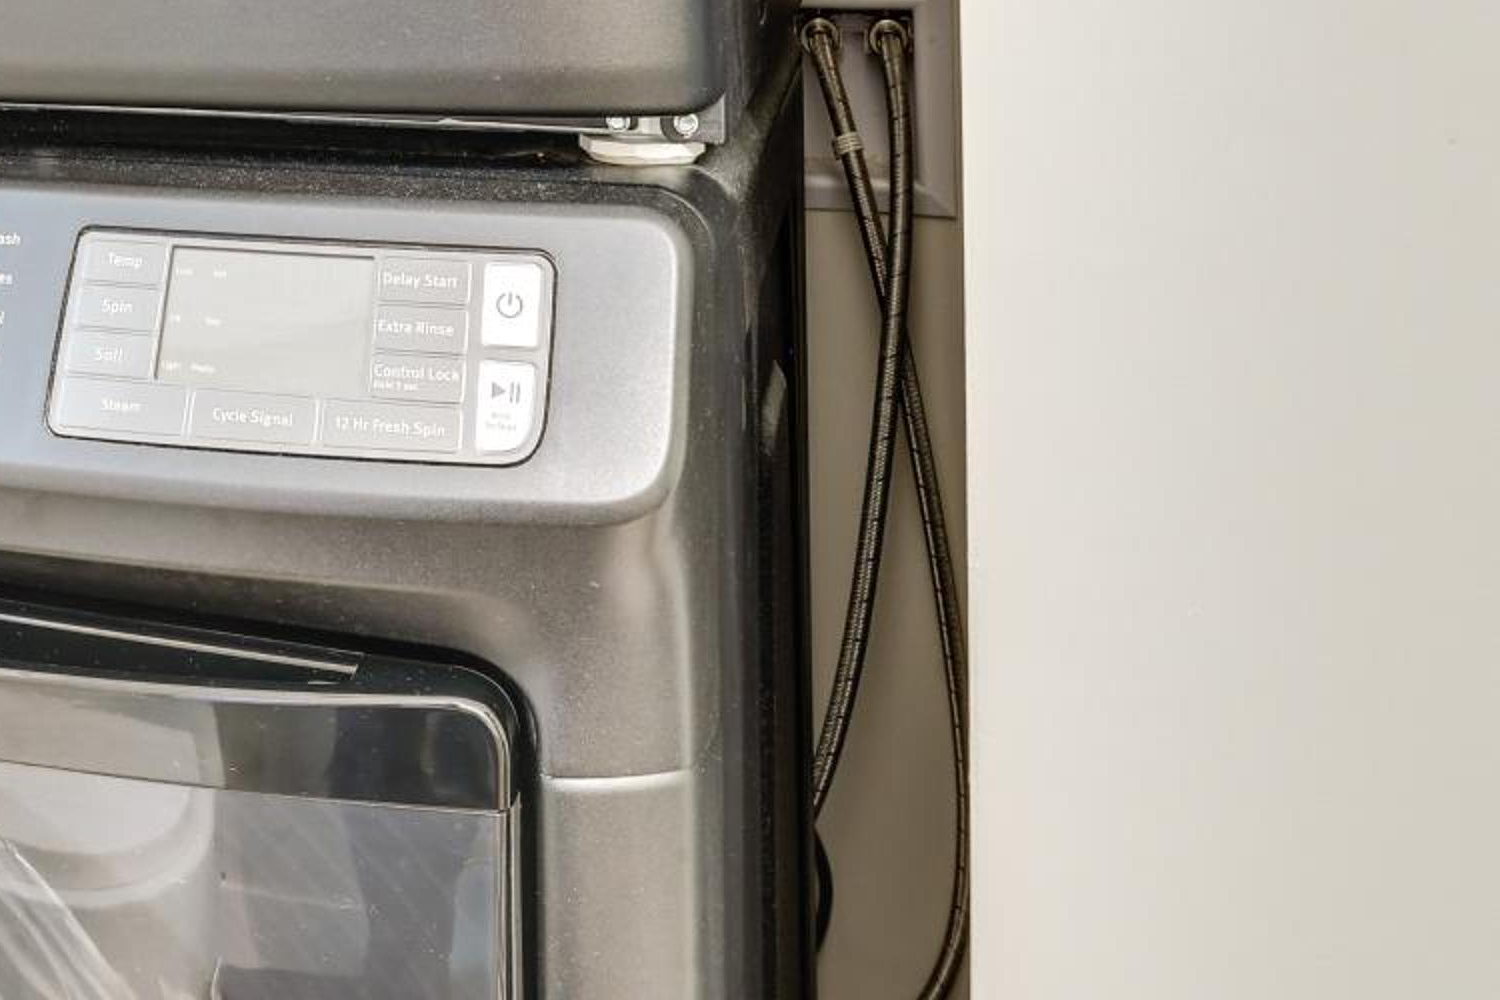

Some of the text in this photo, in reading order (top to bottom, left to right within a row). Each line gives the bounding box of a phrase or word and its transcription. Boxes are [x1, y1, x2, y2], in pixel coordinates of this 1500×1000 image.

[108, 252, 143, 269] Temp
[382, 270, 459, 289] Delay Start
[101, 299, 133, 316] Spin
[377, 318, 413, 334] Extra
[373, 363, 460, 383] Control Lock
[212, 406, 293, 428] Cycle Signal
[335, 416, 446, 438] 12 Hr Fresh Spin
